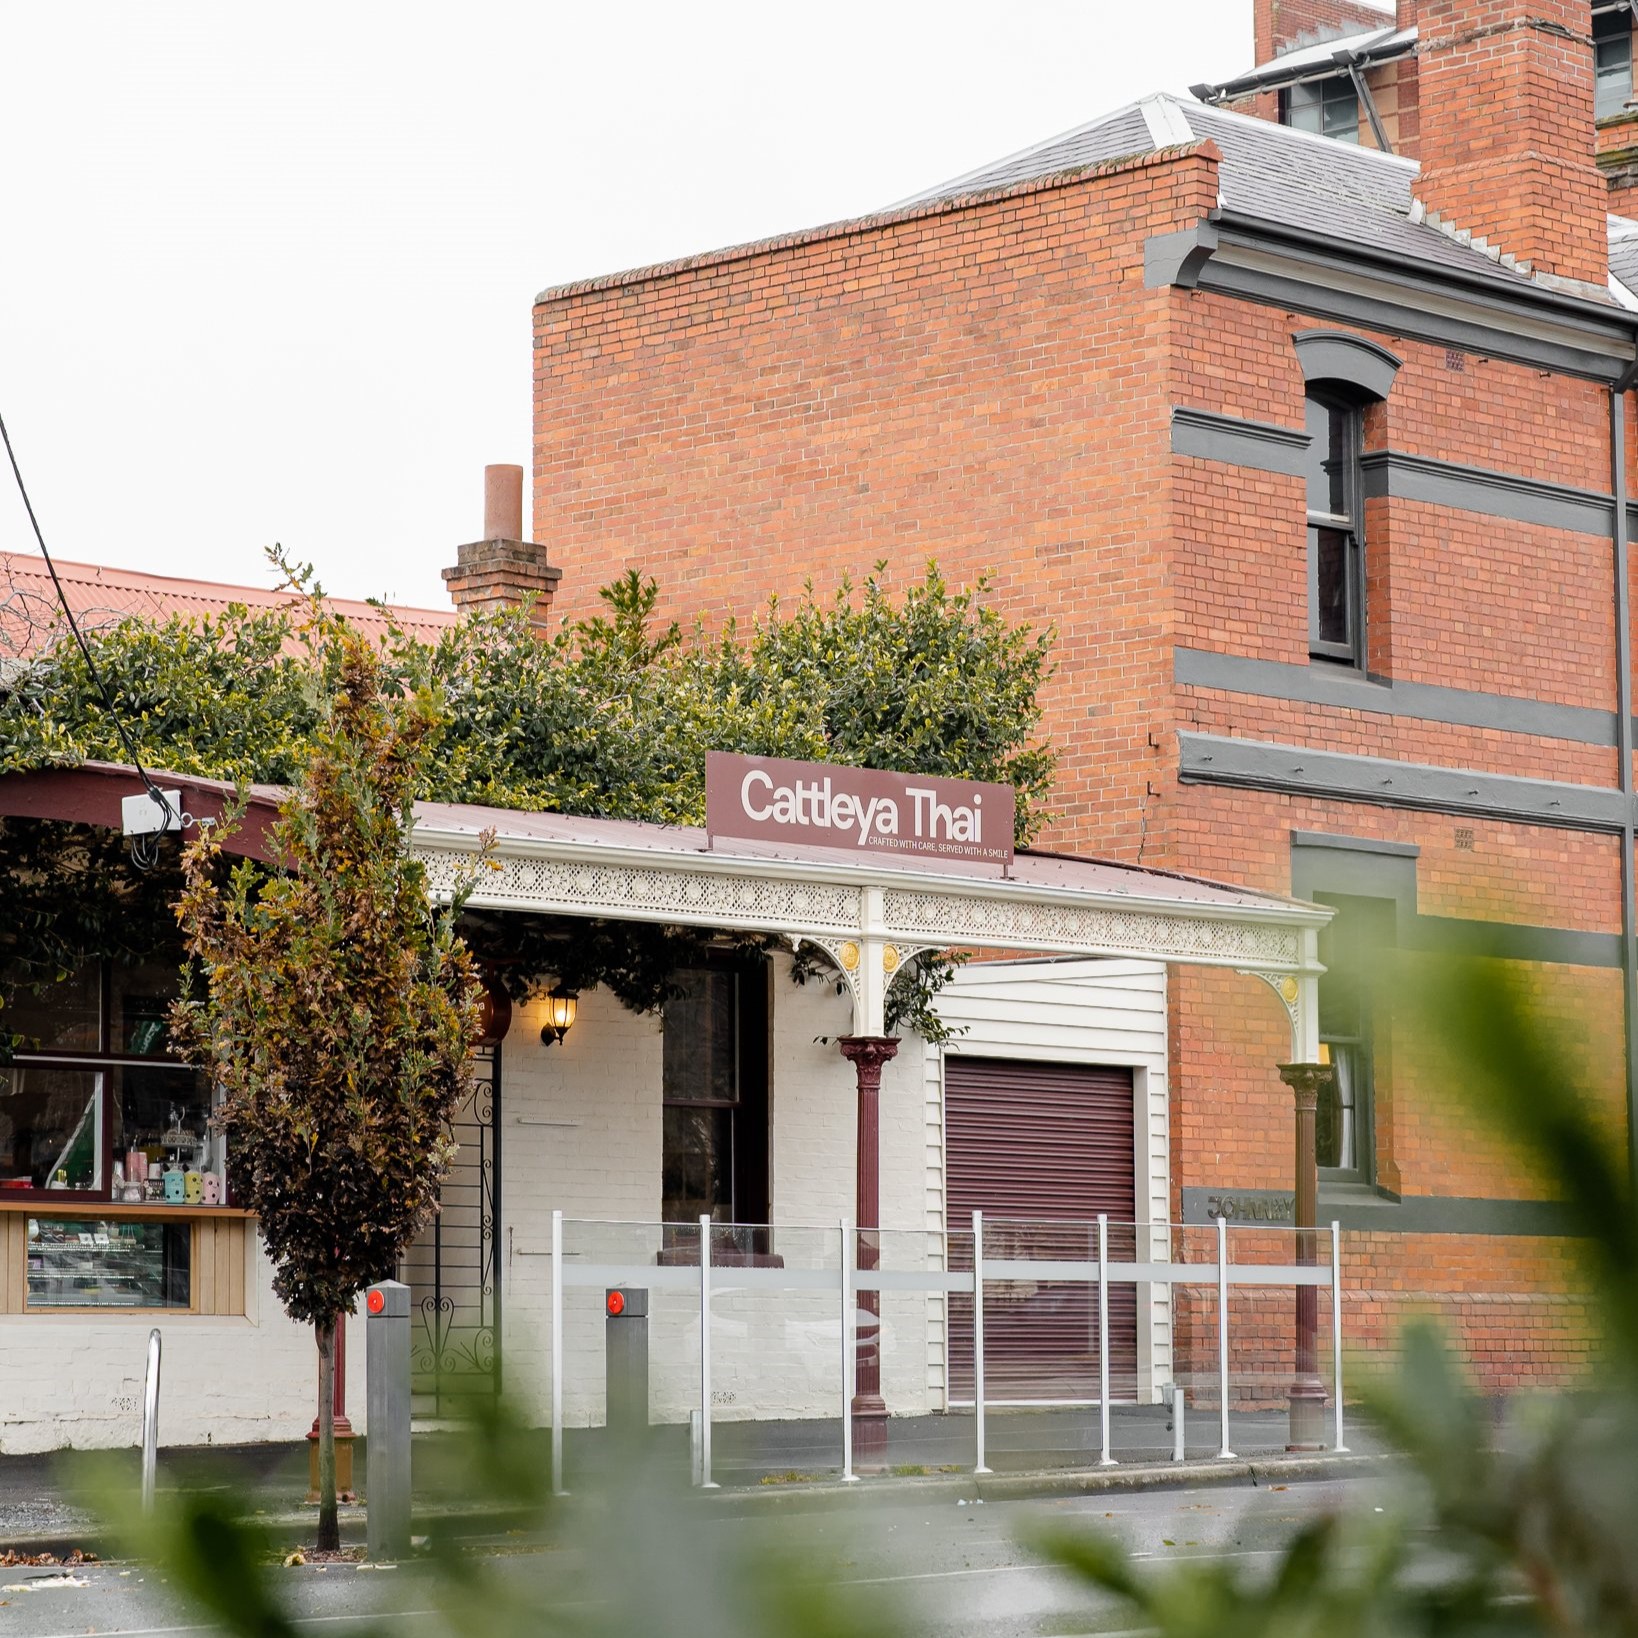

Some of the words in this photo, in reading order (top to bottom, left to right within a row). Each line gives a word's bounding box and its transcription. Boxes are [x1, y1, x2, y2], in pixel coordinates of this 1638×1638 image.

[741, 770, 898, 845] Cattleya
[905, 787, 982, 843] Thai
[868, 836, 899, 848] CRAFTED
[899, 839, 917, 849] WITH
[918, 841, 938, 852] CARE,
[938, 843, 965, 855] SERVED
[964, 846, 981, 856] WITH
[983, 847, 988, 856] A
[988, 848, 1008, 859] SMILE
